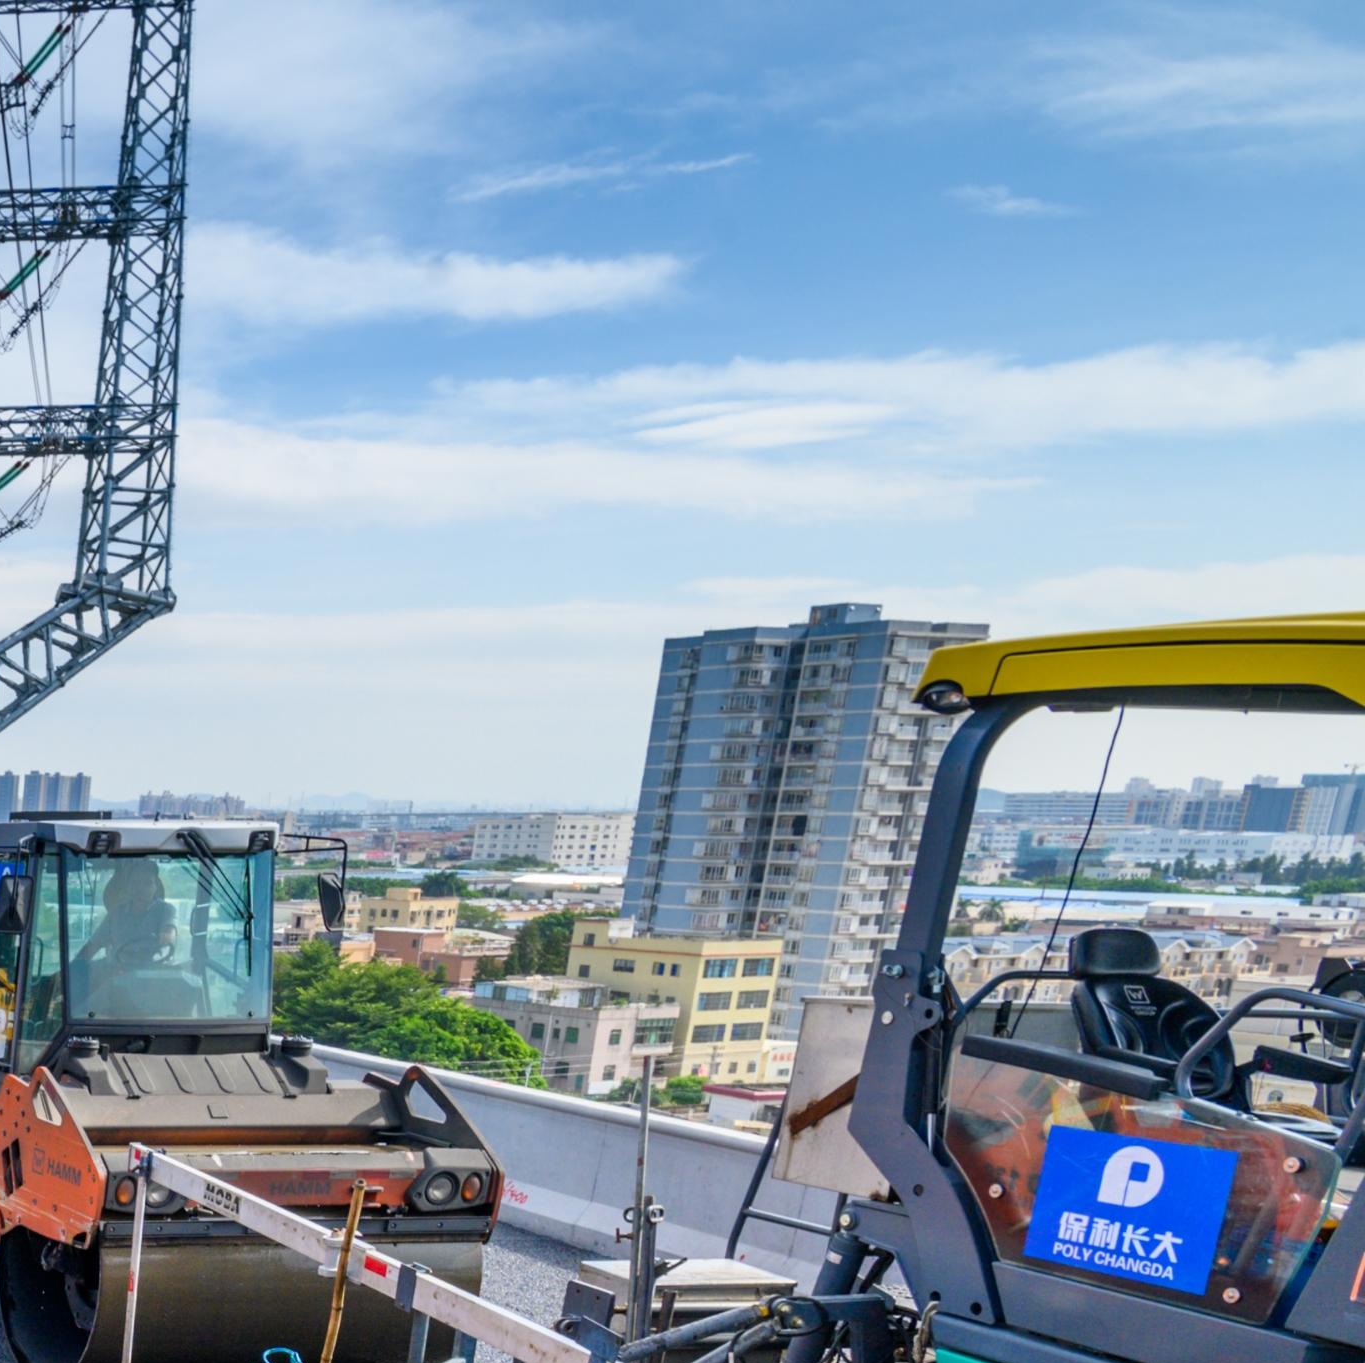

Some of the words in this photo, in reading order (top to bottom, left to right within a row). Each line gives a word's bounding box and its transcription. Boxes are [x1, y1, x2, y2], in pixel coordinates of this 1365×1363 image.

[47, 1158, 82, 1187] HAMM
[203, 1183, 241, 1214] MOBA
[269, 1181, 330, 1196] HAMM
[1058, 1211, 1183, 1263] 保利长大
[1053, 1242, 1092, 1262] POLY
[1094, 1251, 1174, 1280] CHANGDA
